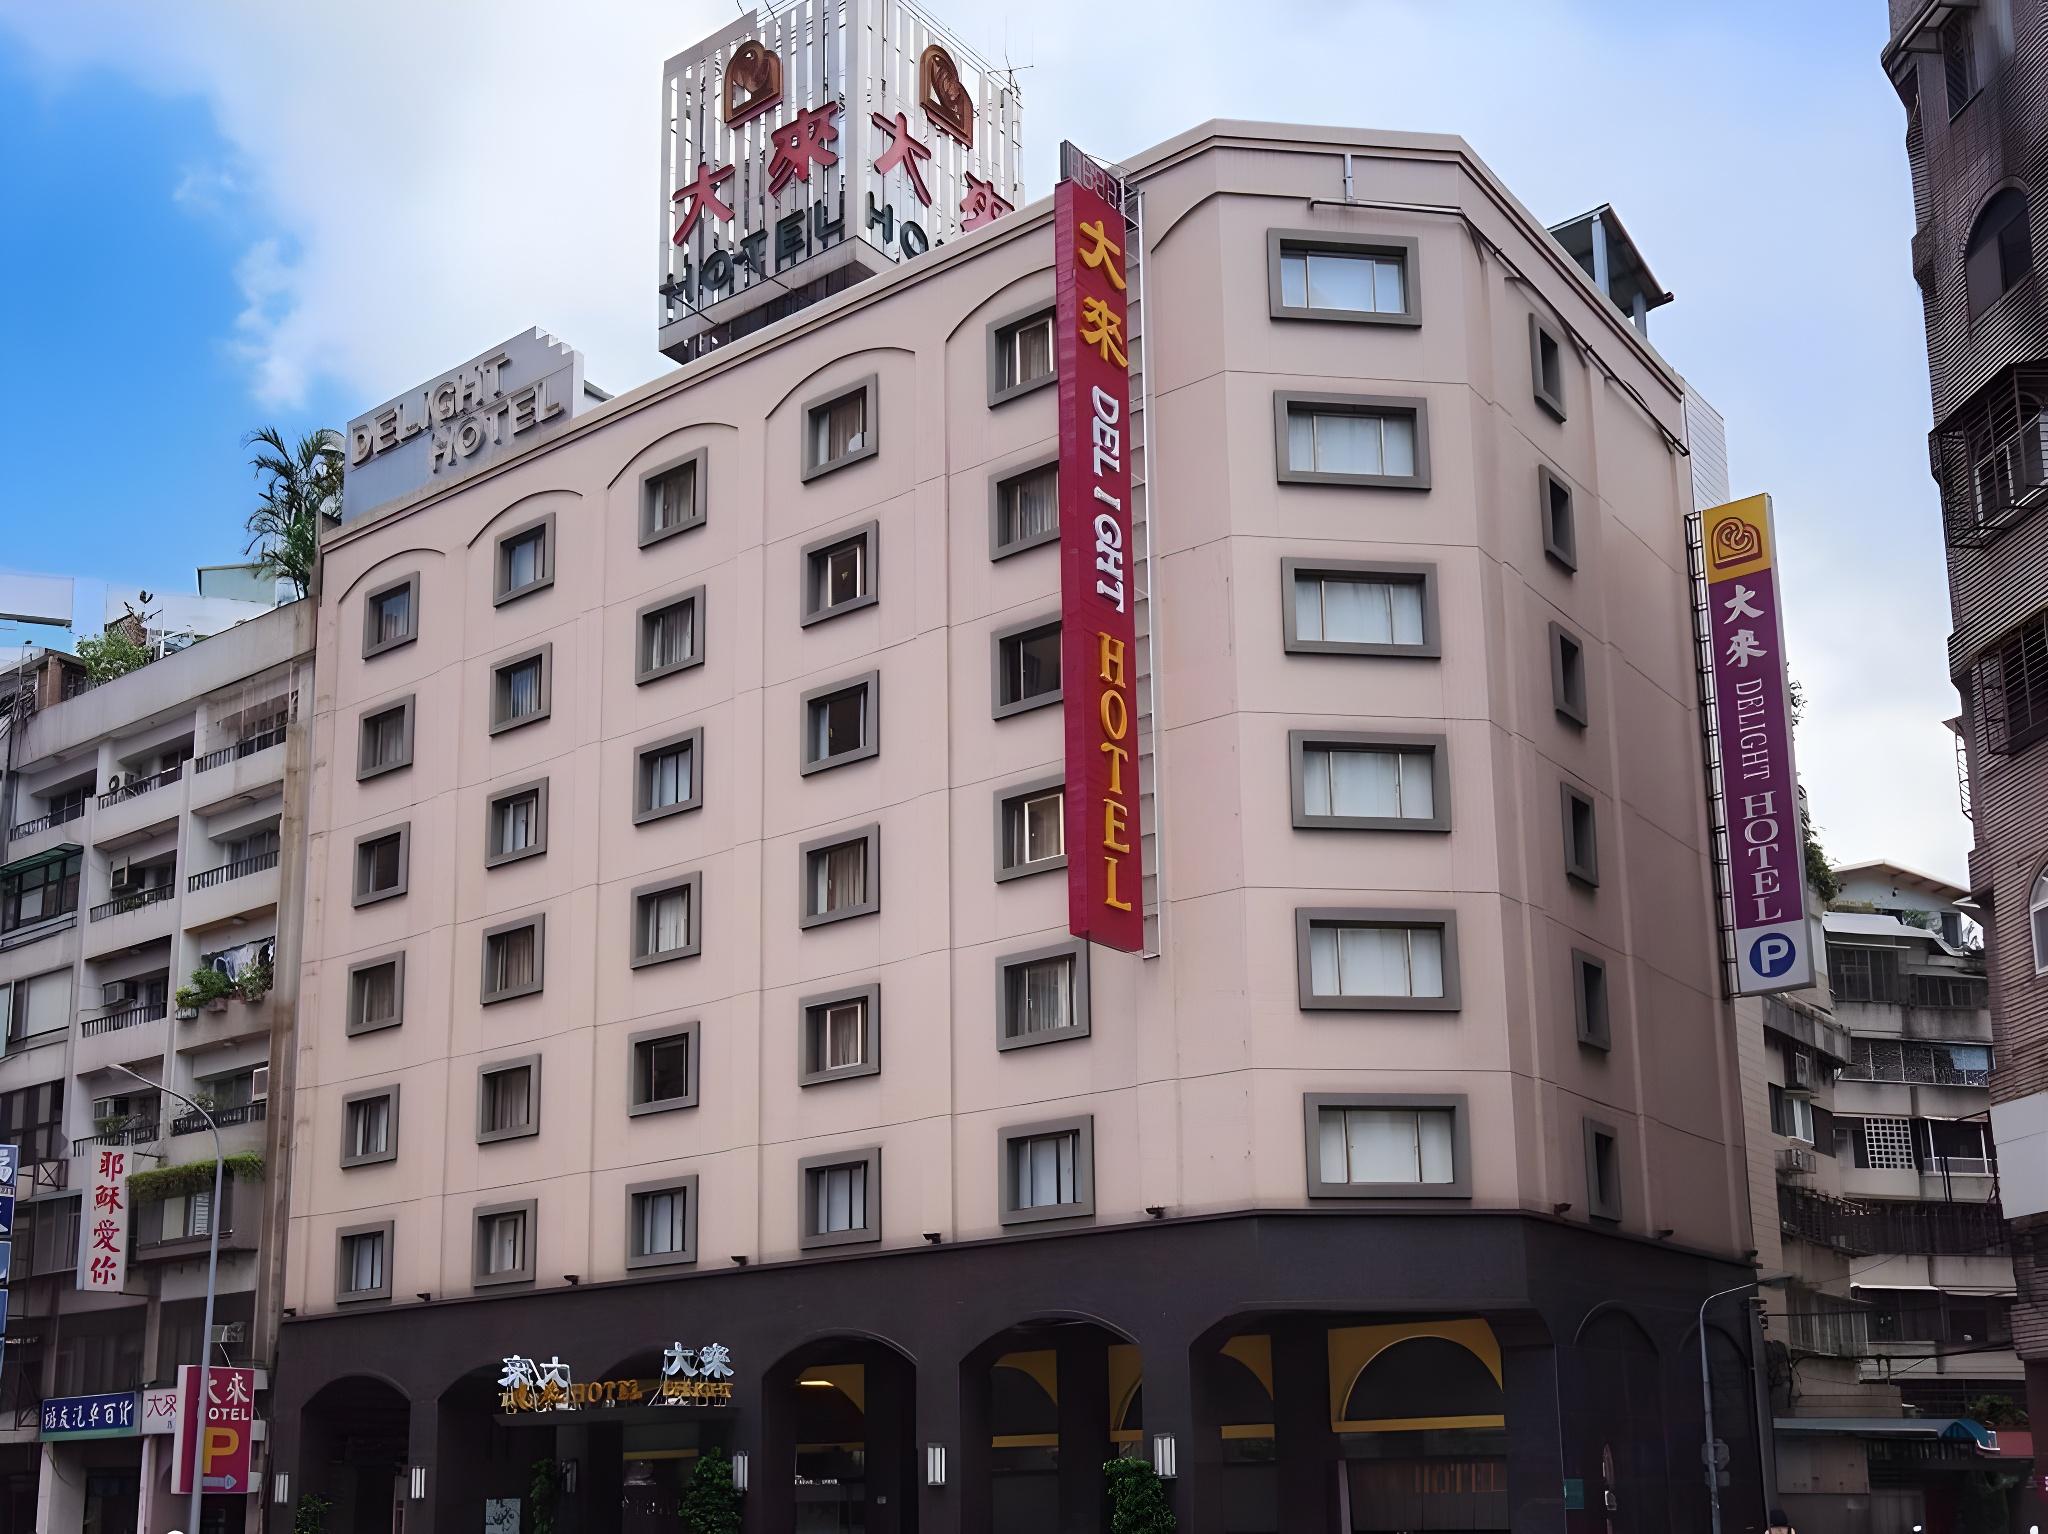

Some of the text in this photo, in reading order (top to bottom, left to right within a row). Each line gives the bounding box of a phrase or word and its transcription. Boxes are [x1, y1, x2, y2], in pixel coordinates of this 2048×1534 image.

[659, 199, 845, 306] HOTEL
[351, 351, 513, 467] DELIGHT
[431, 376, 566, 474] HOTEL
[1091, 385, 1126, 613] DELIGHT
[1097, 631, 1132, 912] HOTEL
[1735, 677, 1771, 780] DELIGHT
[1740, 790, 1782, 922] HOTEL
[1759, 937, 1789, 974] P
[199, 1407, 250, 1421] OTEL
[203, 1426, 240, 1474] P
